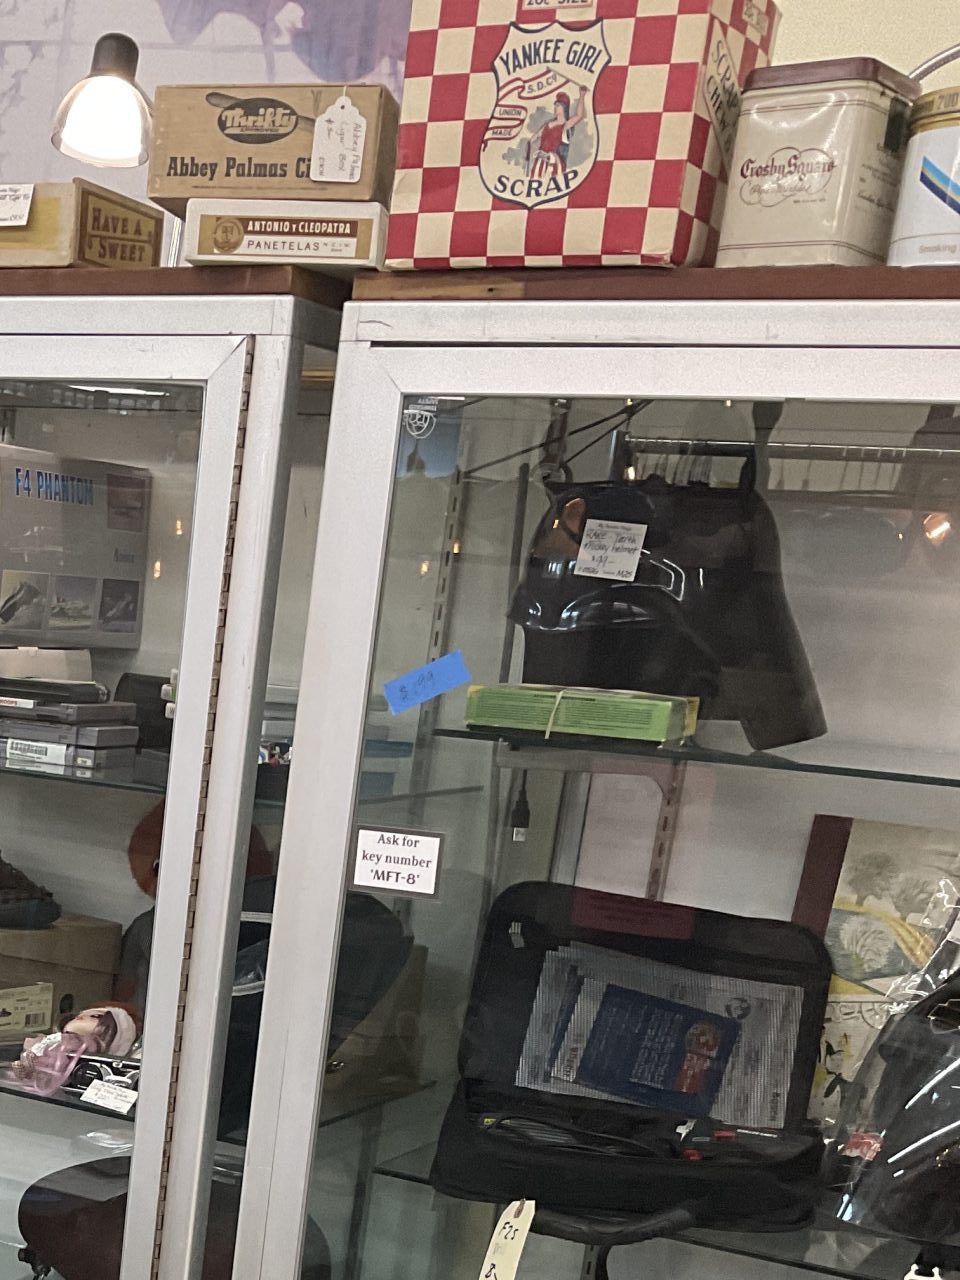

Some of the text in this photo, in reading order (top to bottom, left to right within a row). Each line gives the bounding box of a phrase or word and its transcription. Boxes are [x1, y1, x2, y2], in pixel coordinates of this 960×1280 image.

[499, 38, 602, 76] YANKEE GIRL
[221, 107, 297, 133] Thrifty
[498, 108, 522, 117] UNION
[491, 128, 513, 137] MADE
[166, 156, 218, 181] Abbey
[224, 157, 288, 178] Palmas
[740, 158, 787, 180] Crosby
[494, 169, 579, 198] SCRAP
[92, 207, 129, 235] HAVE
[247, 220, 290, 234] ANTONIO
[298, 221, 351, 235] CLEOPATRA
[98, 238, 146, 263] SWEET
[247, 240, 320, 252] PANETELAS
[15, 468, 94, 506] F4 PHANTOM
[377, 833, 420, 848] Ask for
[361, 850, 433, 869] key number
